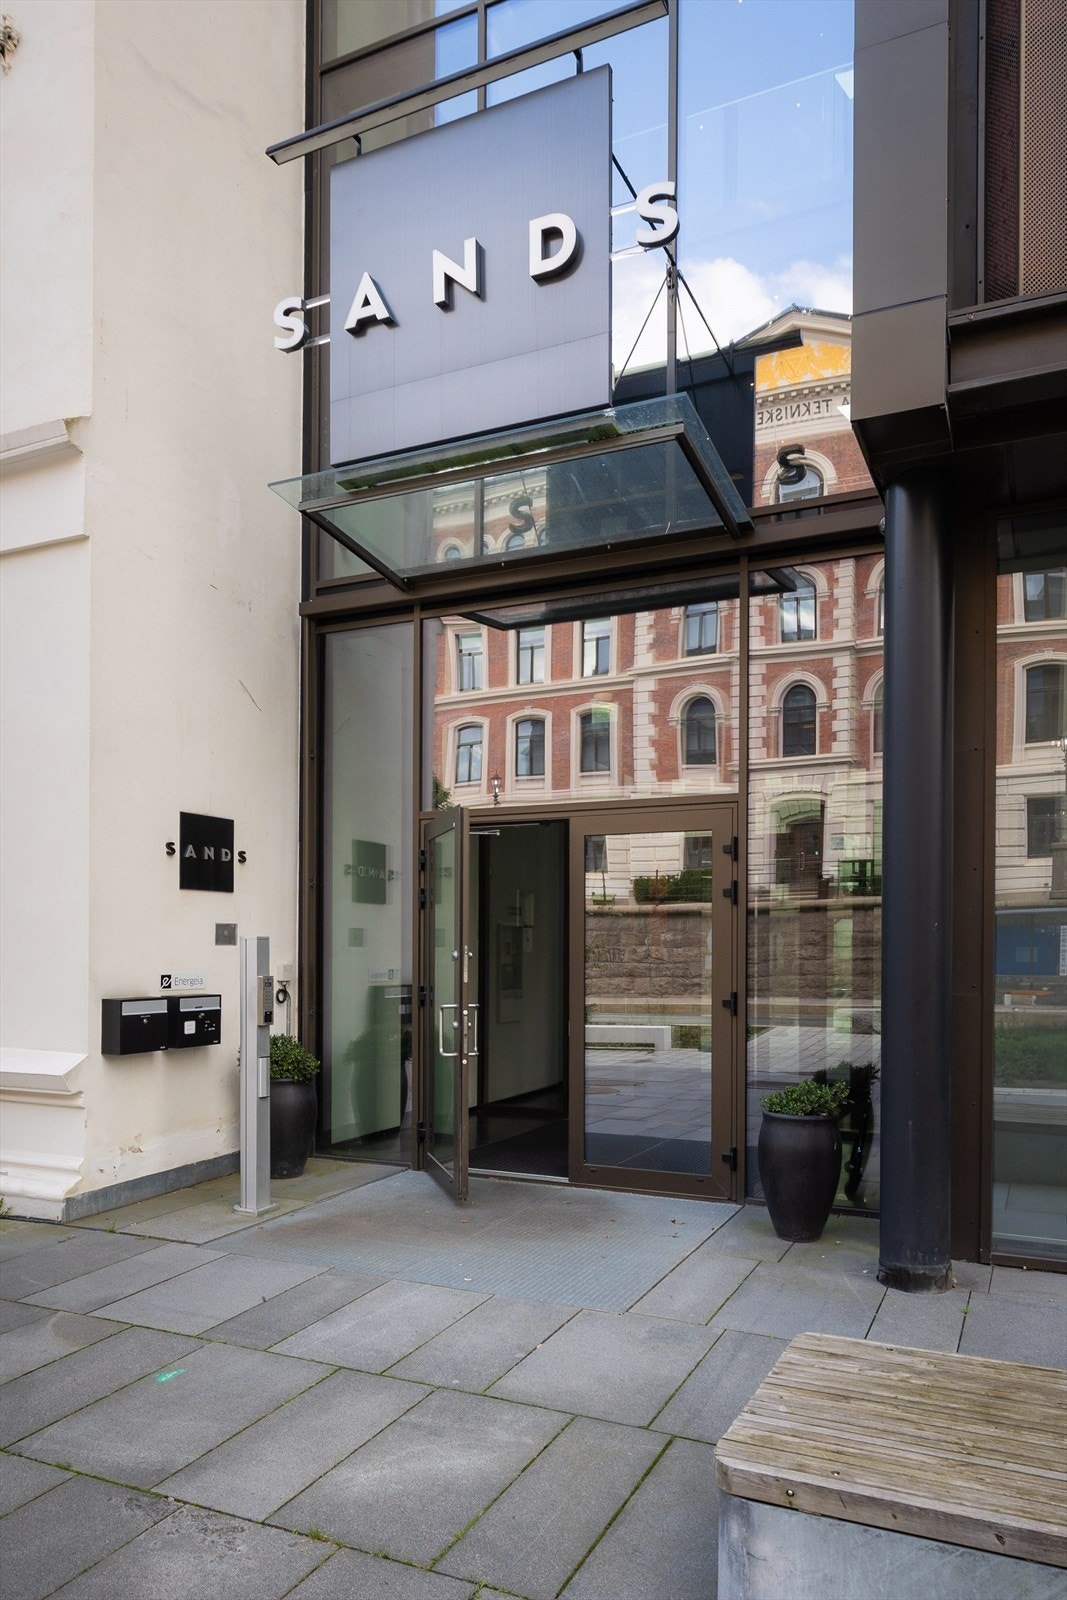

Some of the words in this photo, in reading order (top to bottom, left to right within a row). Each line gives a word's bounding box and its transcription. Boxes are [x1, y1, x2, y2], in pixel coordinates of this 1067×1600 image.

[274, 181, 680, 353] SANDS
[165, 841, 247, 864] SANDS
[174, 976, 204, 987] Energeia
